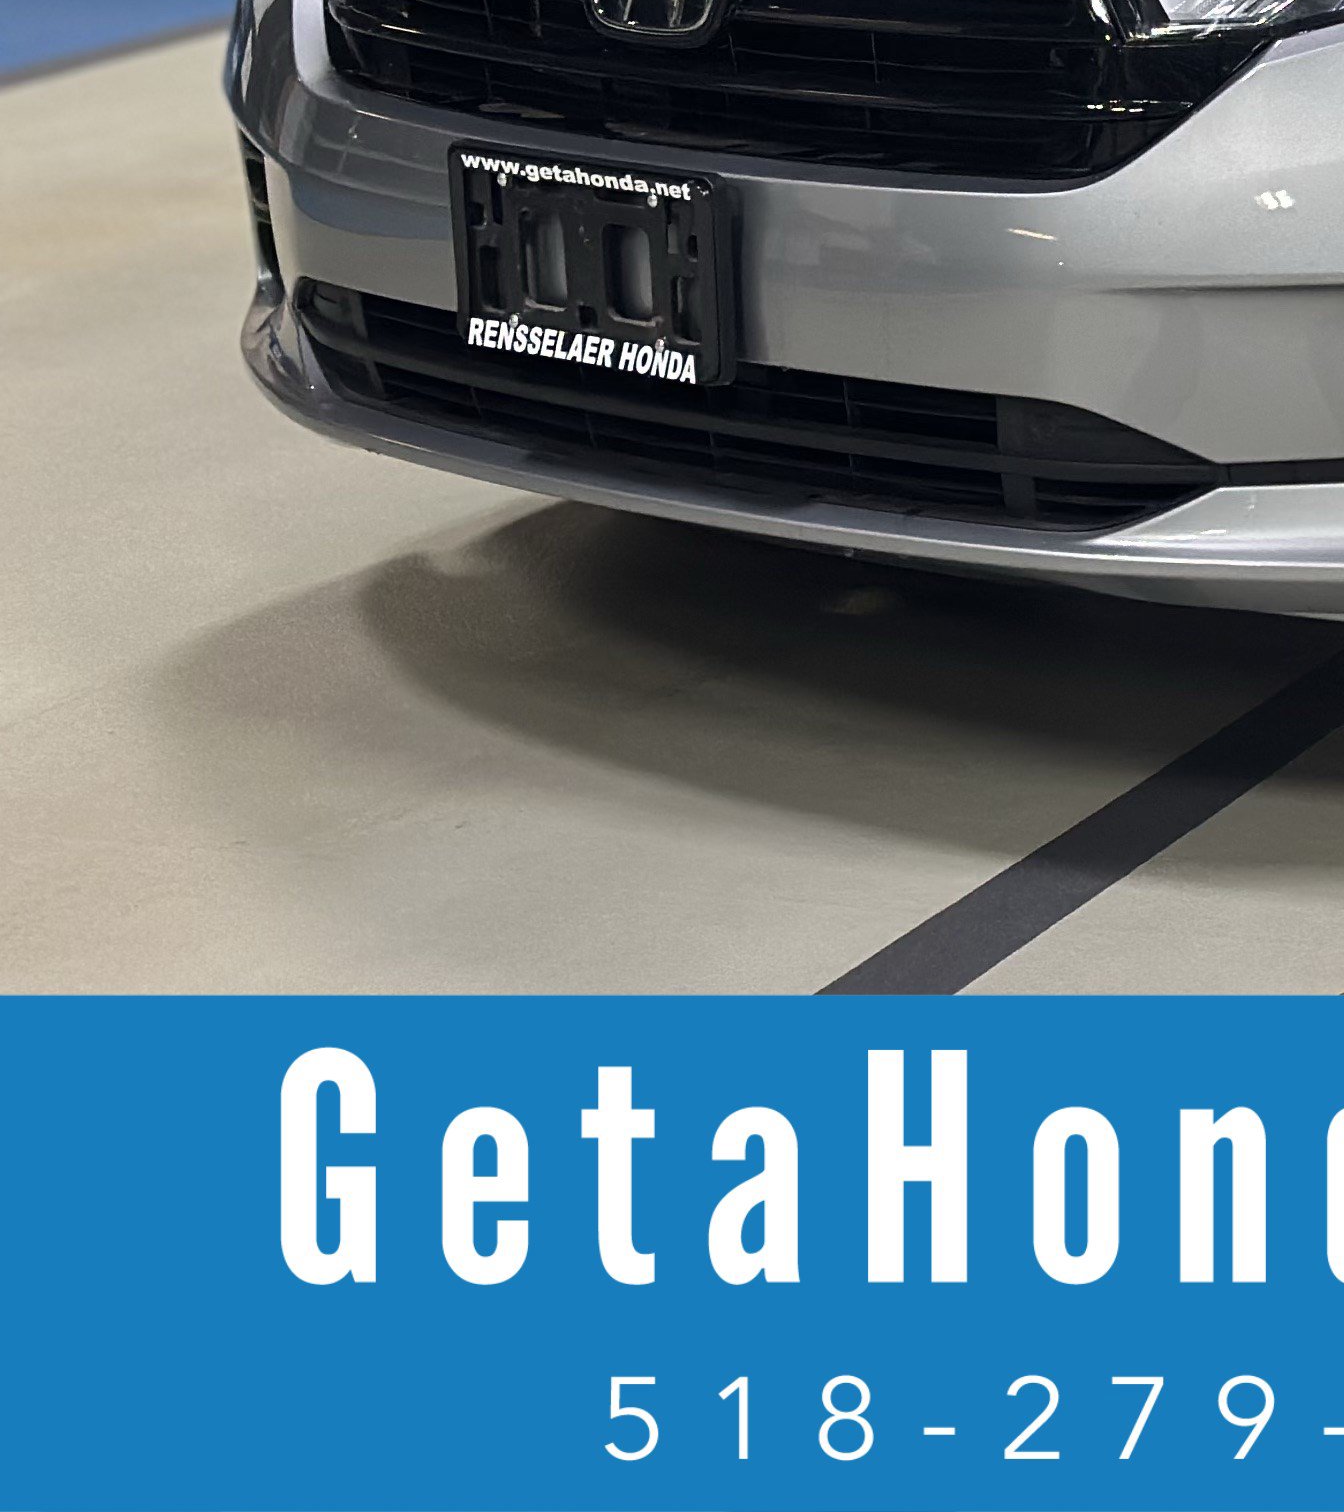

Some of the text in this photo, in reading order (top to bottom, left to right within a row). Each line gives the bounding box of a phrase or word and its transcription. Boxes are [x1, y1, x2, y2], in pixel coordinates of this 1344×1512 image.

[460, 153, 692, 201] www.getahonda.net
[468, 317, 697, 385] RENSSELAER HONDA
